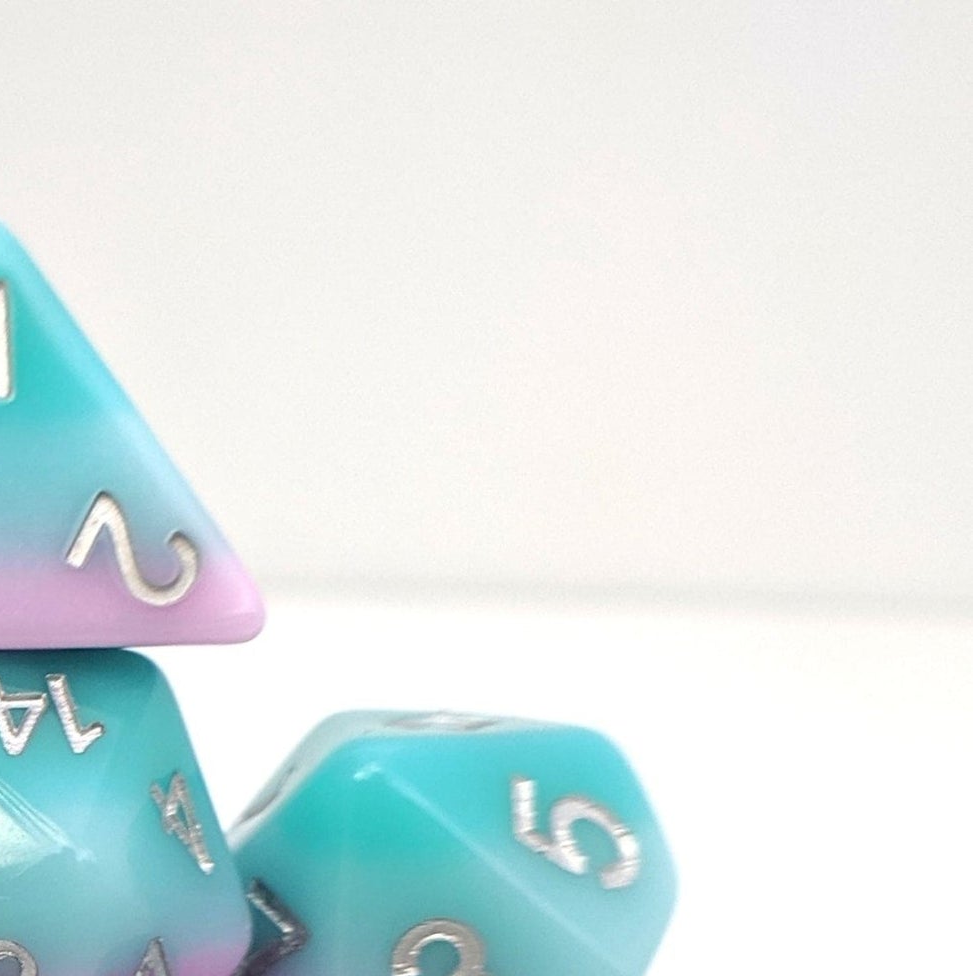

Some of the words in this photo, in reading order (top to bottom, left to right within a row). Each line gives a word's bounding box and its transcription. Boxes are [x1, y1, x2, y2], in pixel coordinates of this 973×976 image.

[66, 490, 199, 607] 2
[150, 771, 216, 875] 4
[511, 774, 641, 891] 5
